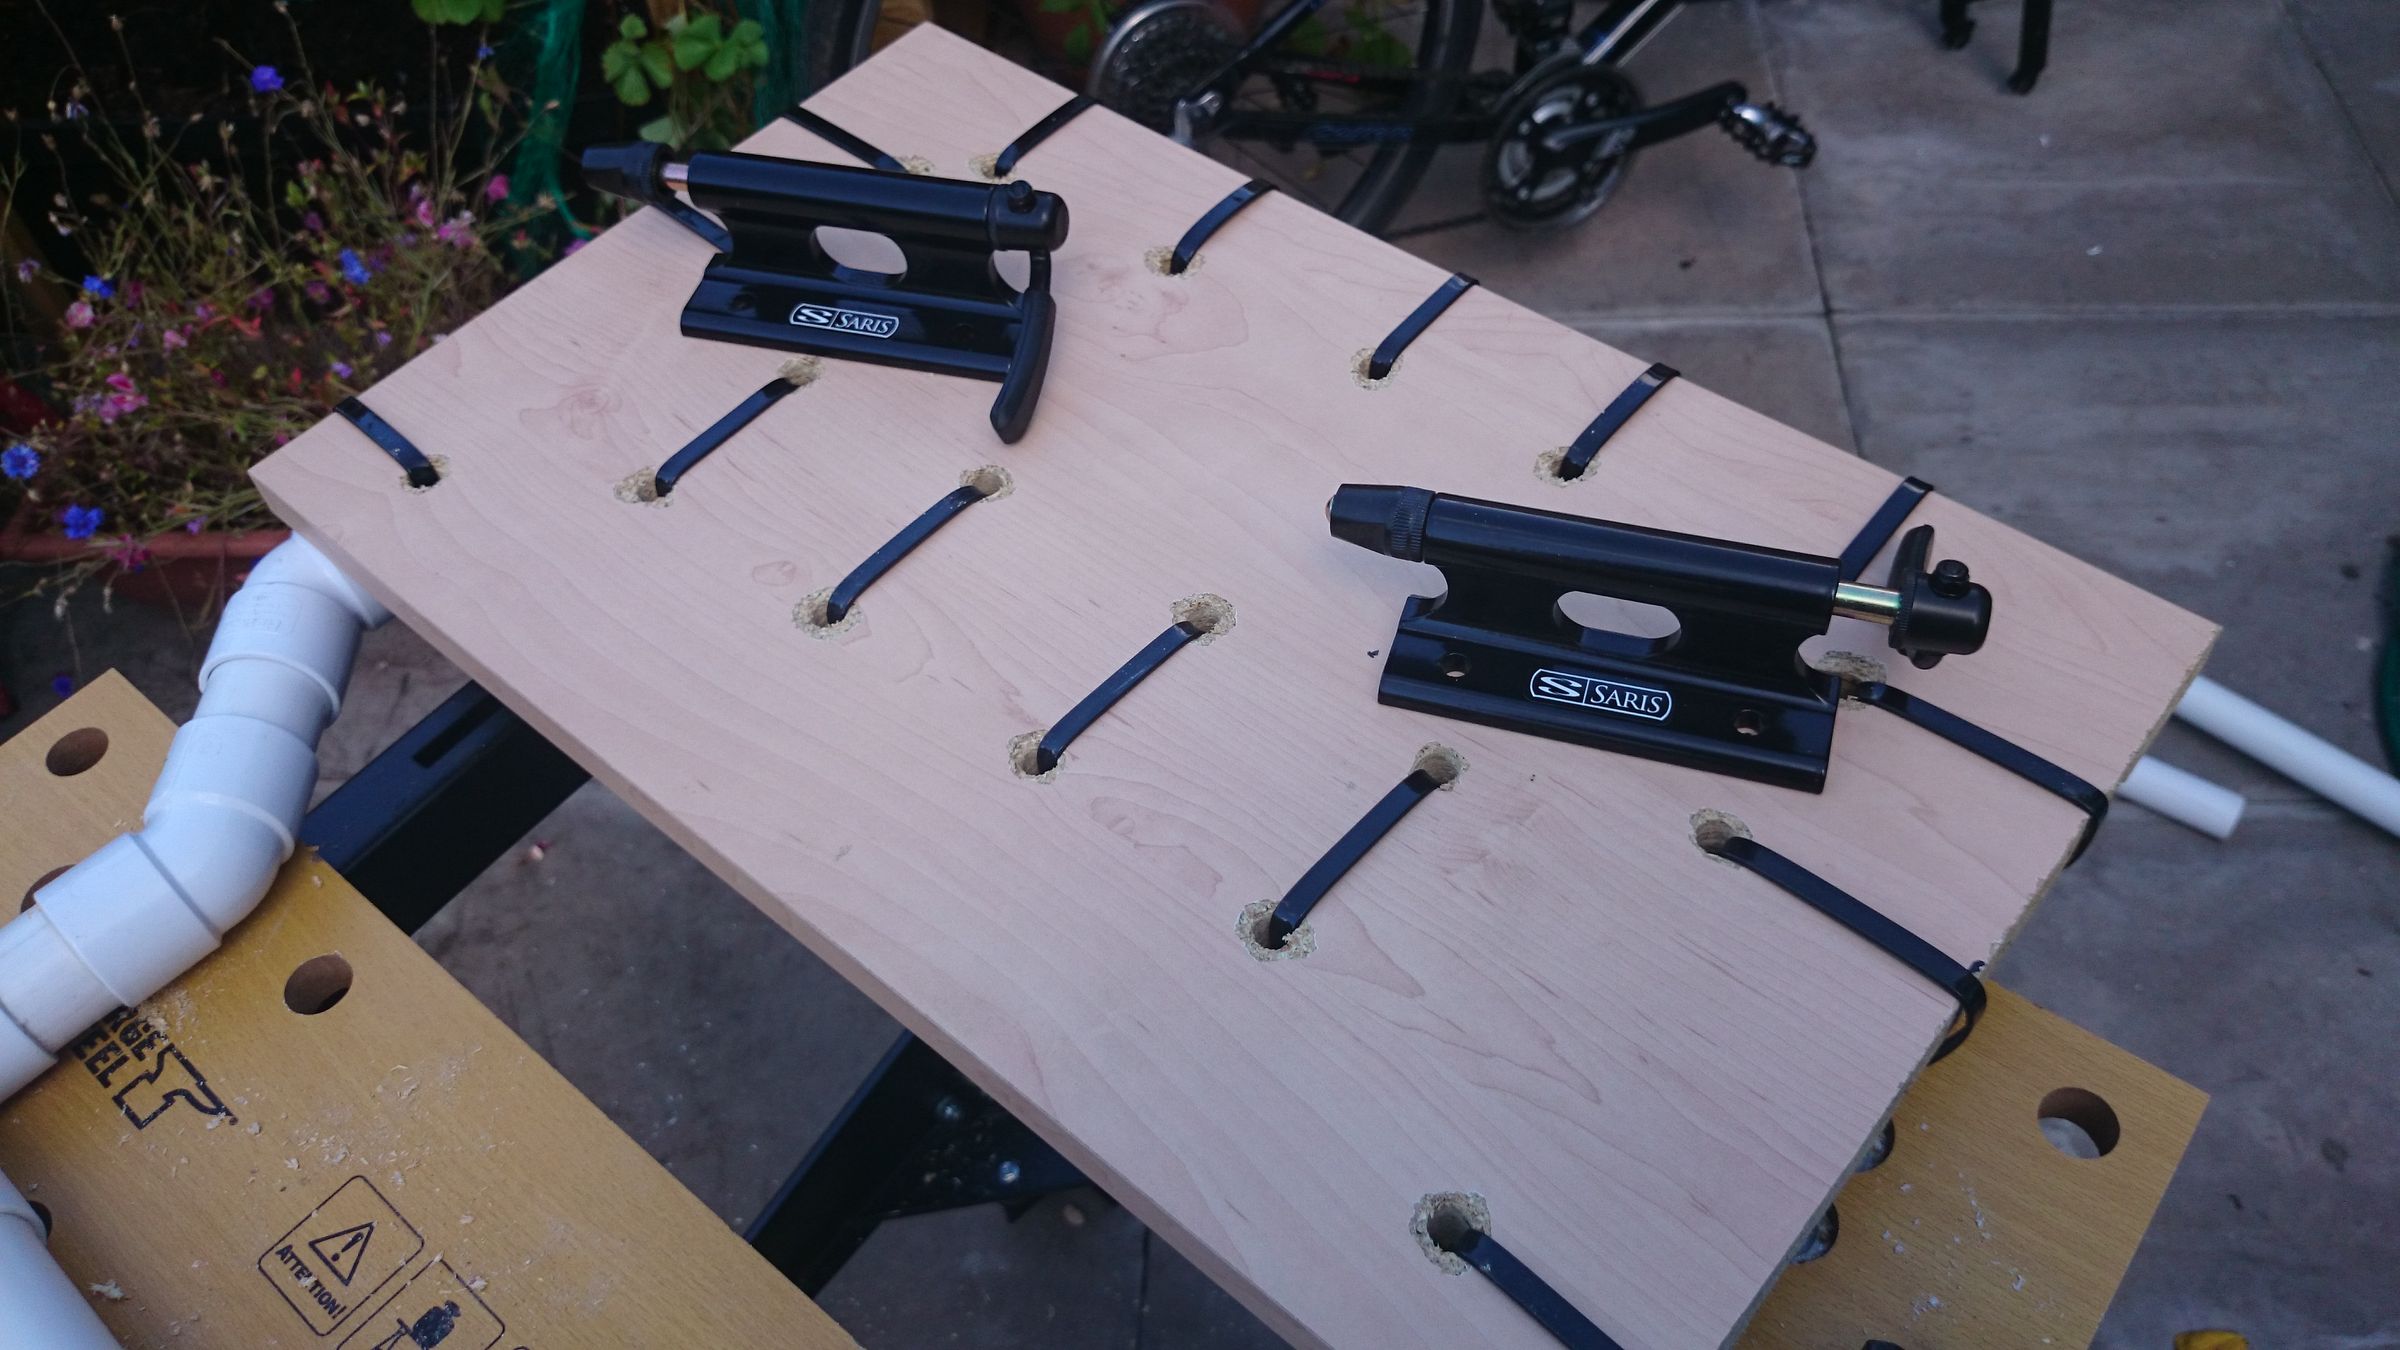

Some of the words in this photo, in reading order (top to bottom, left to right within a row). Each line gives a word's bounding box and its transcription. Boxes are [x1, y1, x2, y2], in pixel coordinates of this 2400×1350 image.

[835, 313, 892, 334] SARIS
[1590, 685, 1663, 714] SARIS
[72, 1026, 130, 1088] EEL
[102, 1004, 168, 1061] RGE
[275, 1244, 347, 1319] ATTETION!
